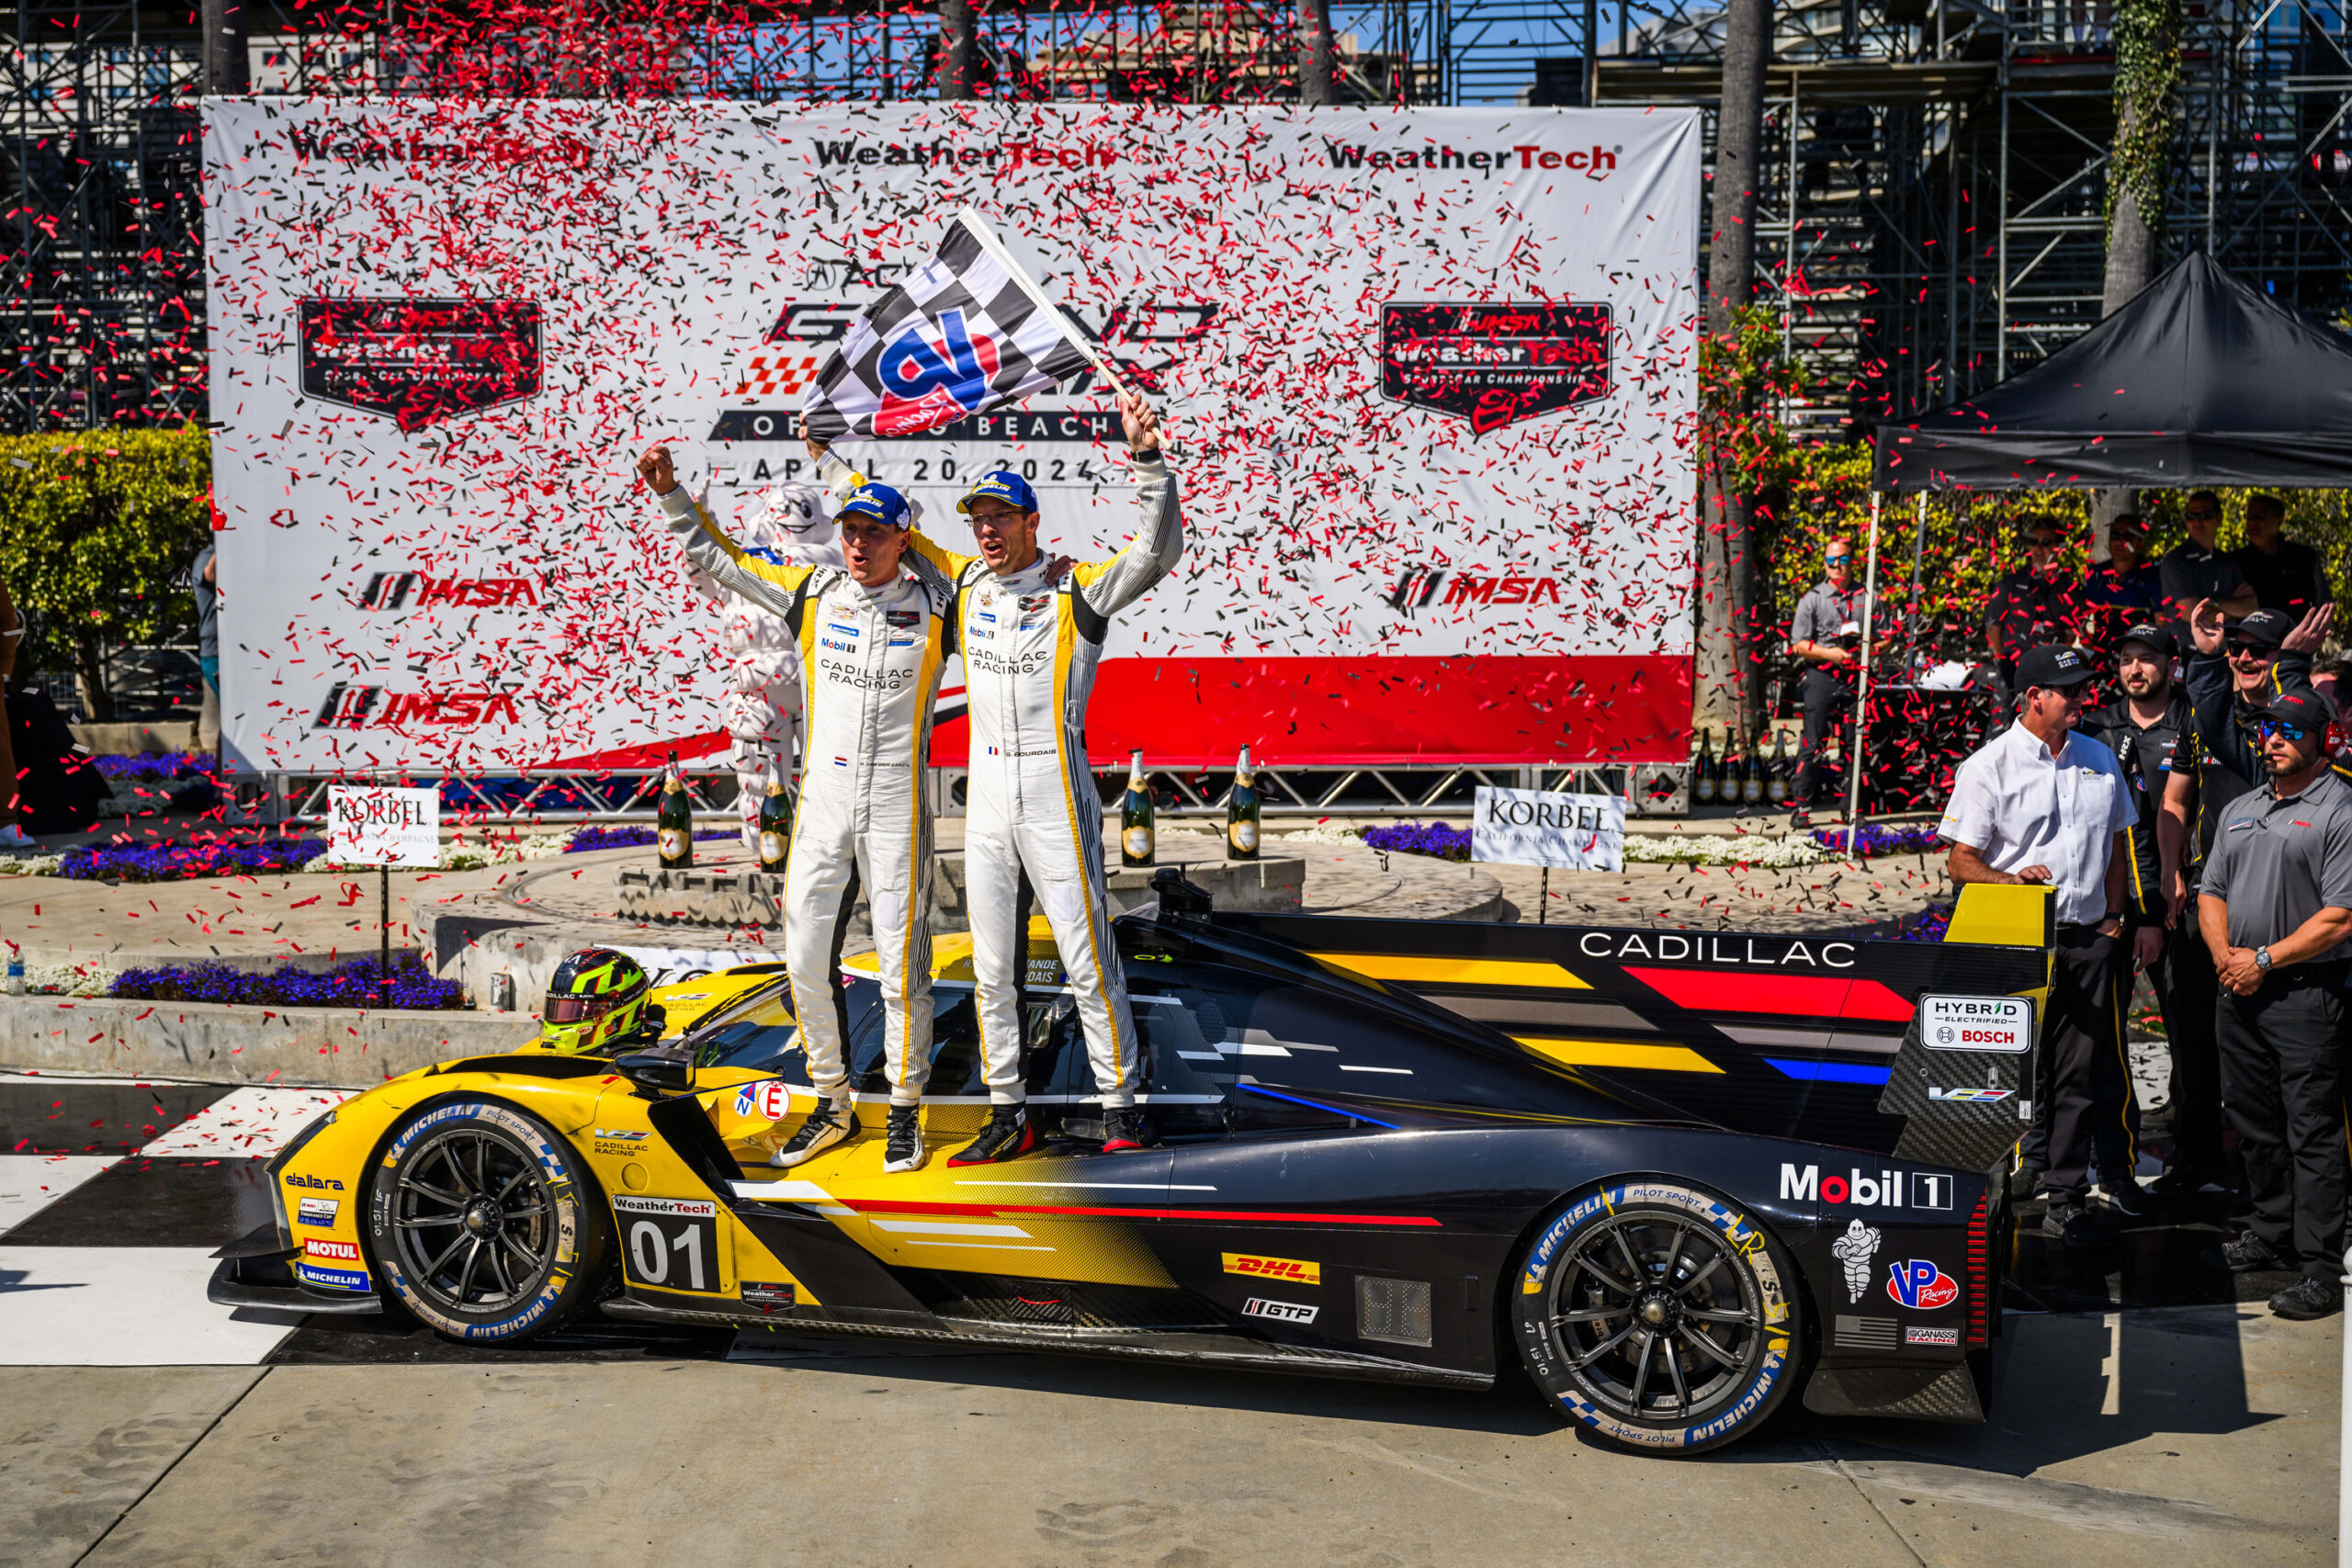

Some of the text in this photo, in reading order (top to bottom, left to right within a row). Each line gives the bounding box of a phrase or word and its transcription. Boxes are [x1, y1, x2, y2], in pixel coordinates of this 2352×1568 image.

[1327, 144, 1617, 171] WeatherTech
[977, 415, 1108, 437] BEACH
[752, 458, 882, 480] APL
[913, 458, 968, 485] 20,
[414, 579, 538, 606] IMSA
[1442, 577, 1561, 604] IMSA
[820, 637, 846, 652] Mobil
[967, 646, 1047, 664] CADILLAC
[820, 659, 913, 679] CADILLAC
[974, 660, 1035, 675] RACING
[829, 672, 901, 690] RACING
[374, 693, 521, 725] IMSA
[2118, 734, 2132, 761] HRX
[338, 796, 427, 826] KORBEL
[1487, 798, 1610, 831] KORBEL
[1476, 829, 1544, 845] CALIFORNIA
[1548, 835, 1620, 851] CHAMPGNE
[1579, 932, 1856, 968] CADILLAC
[1026, 959, 1058, 970] ANDE
[1935, 1001, 2017, 1016] HYBRID
[1944, 1016, 2007, 1024] ELECTRIFIED
[1962, 1030, 2015, 1044] BOSCH
[736, 1098, 749, 1115] N
[765, 1087, 782, 1118] E
[401, 1104, 475, 1145] MICHELIN
[486, 1109, 537, 1142] PILOT SPORT
[594, 1141, 649, 1152] CADILLAC
[594, 1148, 636, 1157] RACING
[286, 1172, 345, 1191] dallara
[1780, 1162, 1903, 1208] Mobil
[615, 1198, 710, 1214] WeatherTech
[1633, 1189, 1702, 1208] PILOT SPORT
[1537, 1190, 1617, 1262] MICHELIN
[307, 1240, 357, 1258] MOTUL
[630, 1220, 706, 1290] 01
[307, 1270, 361, 1285] MICHELIN
[1236, 1257, 1307, 1280] DHL
[1889, 1258, 1939, 1309] VP
[742, 1290, 793, 1299] WeatherTech
[1920, 1287, 1958, 1303] Racing
[472, 1300, 546, 1337] MICHELIN
[1266, 1303, 1314, 1319] GTP
[436, 1319, 459, 1333] PILOT
[1692, 1371, 1772, 1442] MICHELIN
[1608, 1424, 1643, 1440] SPORT
[1645, 1435, 1676, 1443] PILOT
